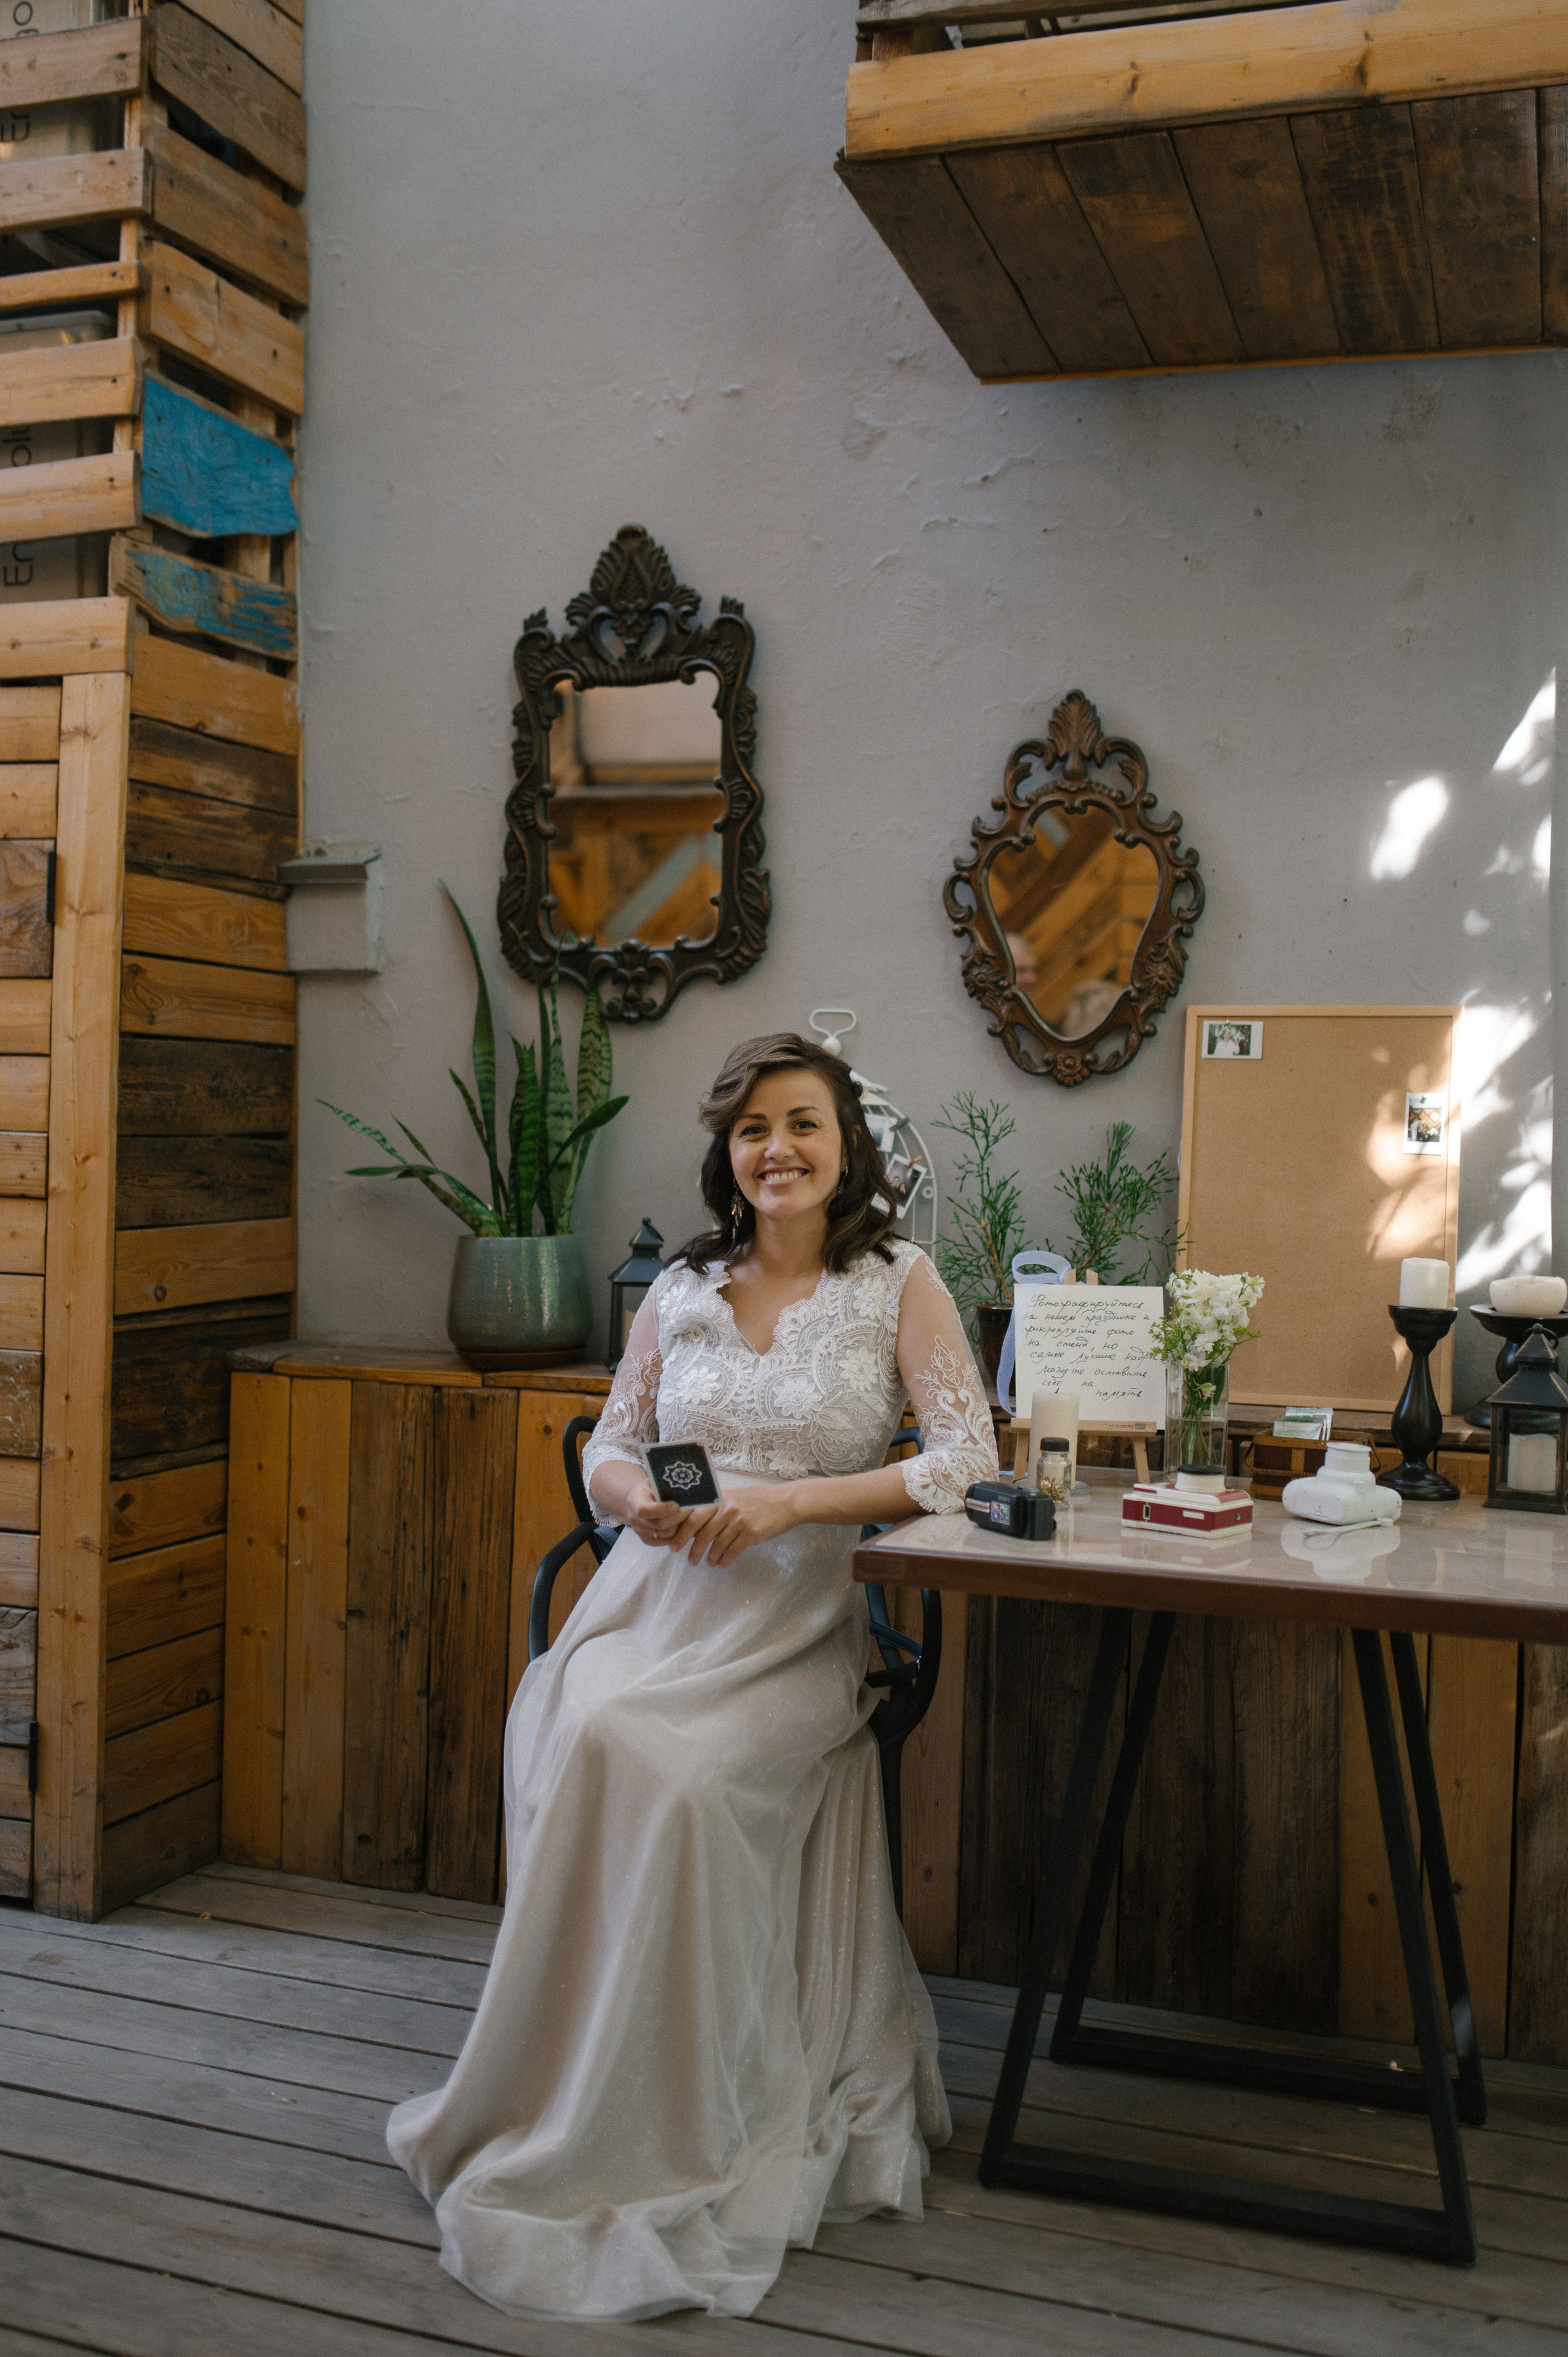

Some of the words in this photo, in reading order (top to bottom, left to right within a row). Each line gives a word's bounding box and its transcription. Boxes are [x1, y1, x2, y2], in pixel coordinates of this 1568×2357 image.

[1027, 1294, 1144, 1316] Фотографируйтесь
[1045, 1314, 1076, 1324] нашем
[1085, 1310, 1136, 1328] празднике
[1106, 1329, 1134, 1339] фото
[1028, 1338, 1041, 1346] на
[1030, 1351, 1065, 1364] самые
[1069, 1352, 1116, 1364] лучшие
[1124, 1346, 1158, 1368] кадры
[1036, 1365, 1085, 1376] можете
[1094, 1366, 1148, 1377] оставить
[1042, 1376, 1063, 1386] себе
[1095, 1388, 1142, 1401] память
